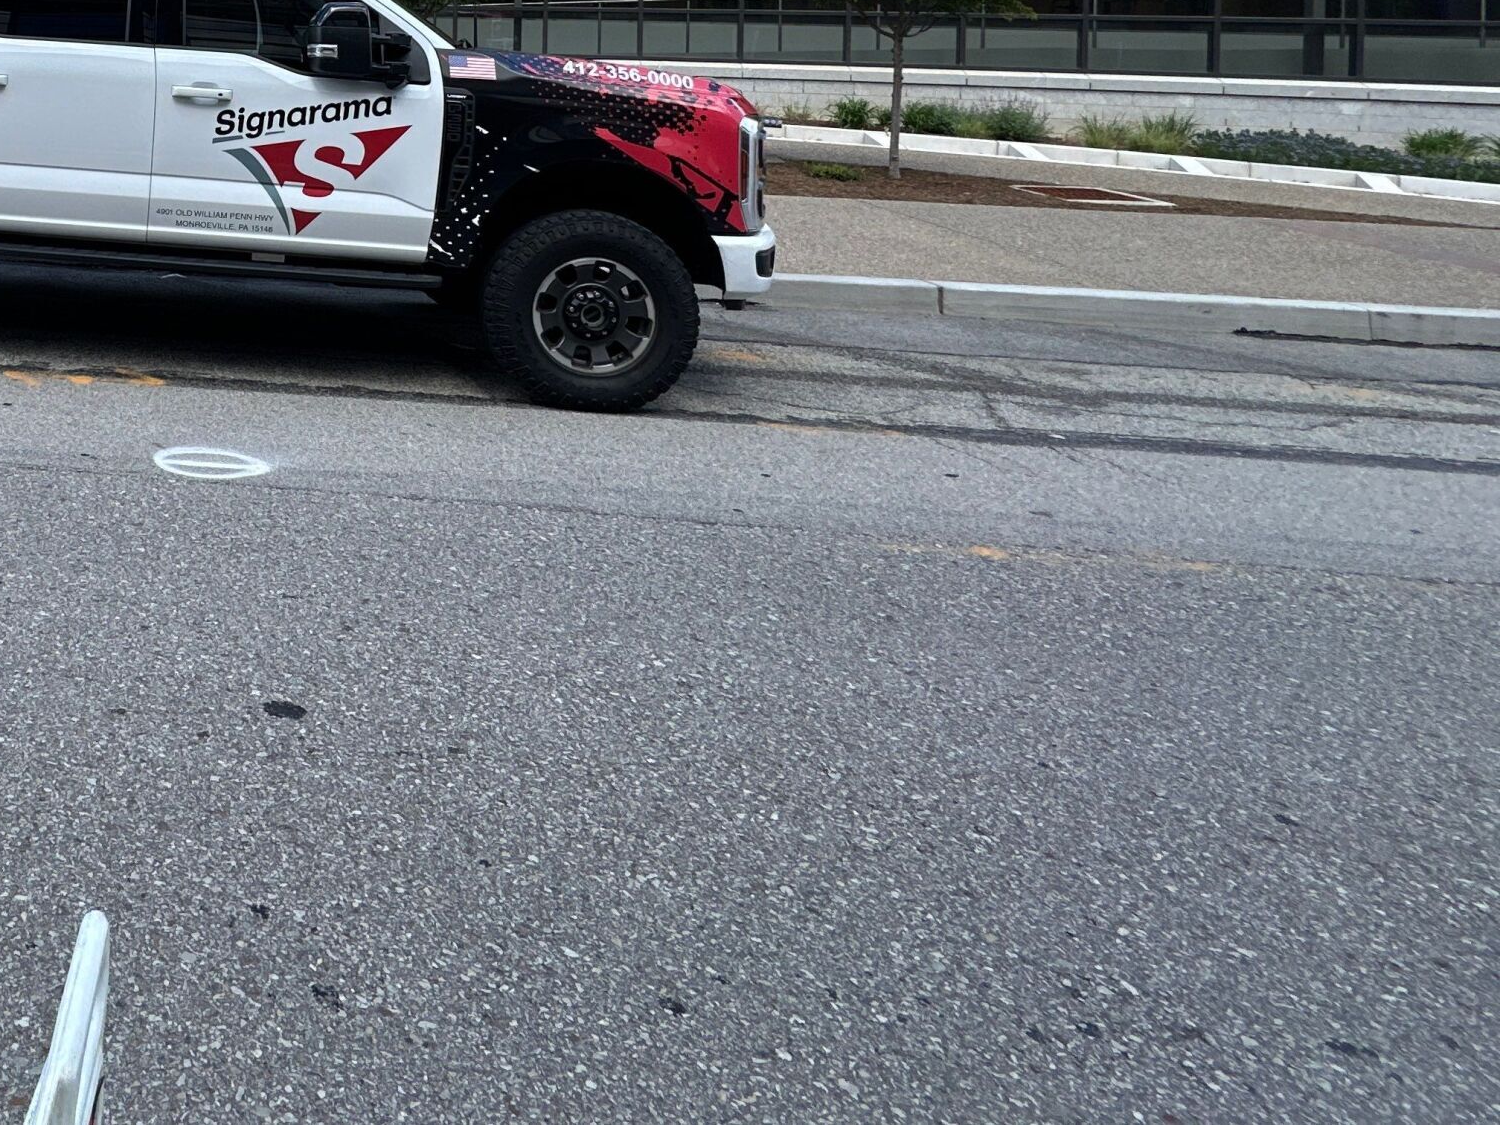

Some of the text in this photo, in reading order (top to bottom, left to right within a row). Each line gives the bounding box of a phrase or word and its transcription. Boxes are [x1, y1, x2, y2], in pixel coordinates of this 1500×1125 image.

[562, 59, 694, 90] 412-356-0000
[214, 95, 394, 139] Signarama
[175, 208, 192, 217] OLD
[194, 209, 228, 220] WILLIAM
[229, 212, 253, 221] PENN
[254, 213, 274, 222] HWY
[238, 223, 249, 232] PA
